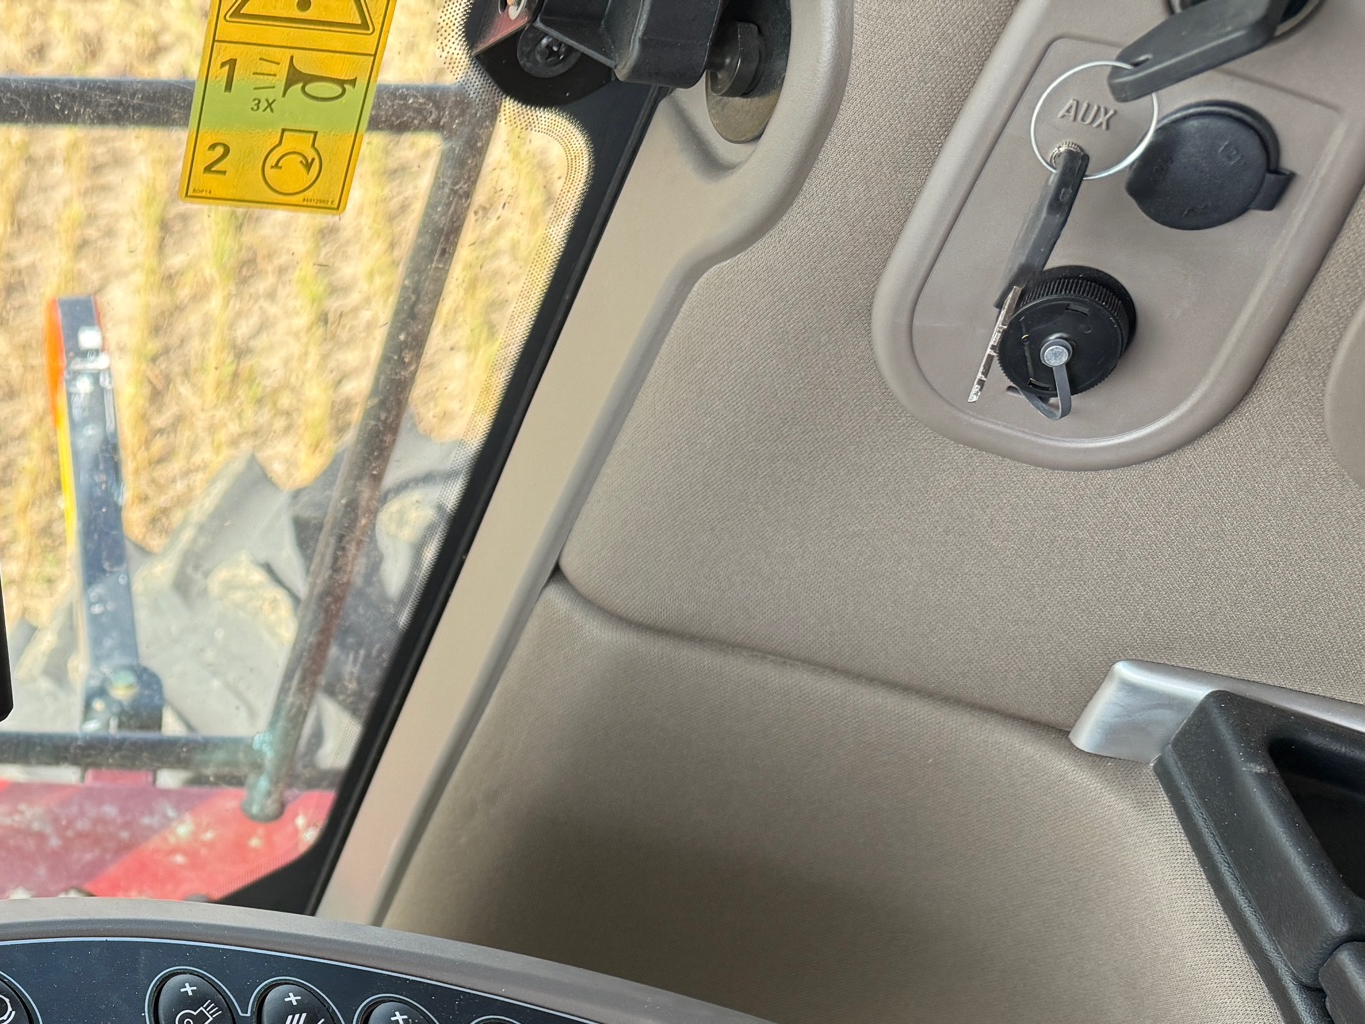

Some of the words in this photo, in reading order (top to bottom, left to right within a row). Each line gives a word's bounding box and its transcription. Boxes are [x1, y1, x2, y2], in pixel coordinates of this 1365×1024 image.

[219, 57, 238, 94] 1
[250, 98, 277, 114] 3X
[1057, 98, 1117, 131] AUX
[202, 141, 231, 177] 2
